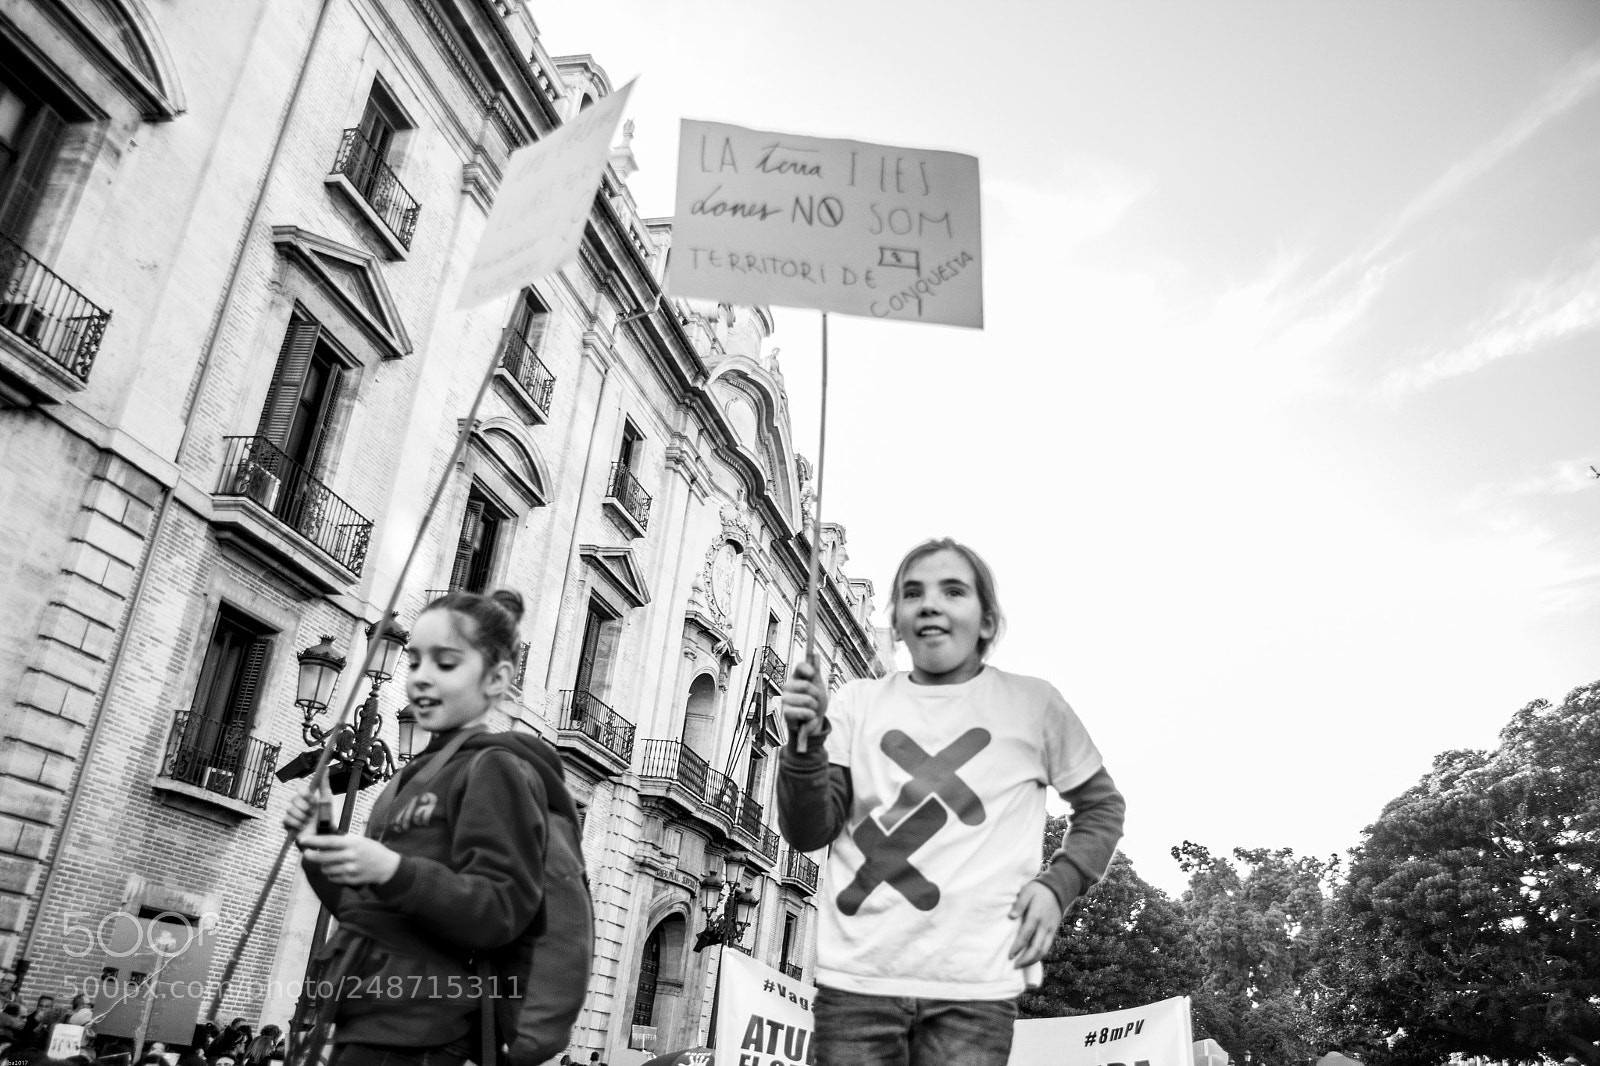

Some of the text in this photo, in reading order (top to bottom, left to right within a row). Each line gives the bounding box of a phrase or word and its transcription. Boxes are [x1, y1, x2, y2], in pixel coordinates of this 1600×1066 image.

[701, 134, 738, 174] LA
[847, 151, 858, 188] I
[879, 156, 930, 197] LES
[691, 184, 953, 239] dones NO SOM
[689, 247, 878, 290] TERRITORI DE
[869, 250, 974, 319] CONQUESTA
[763, 979, 816, 1013] #Vag
[1084, 1018, 1145, 1047] #8mPV
